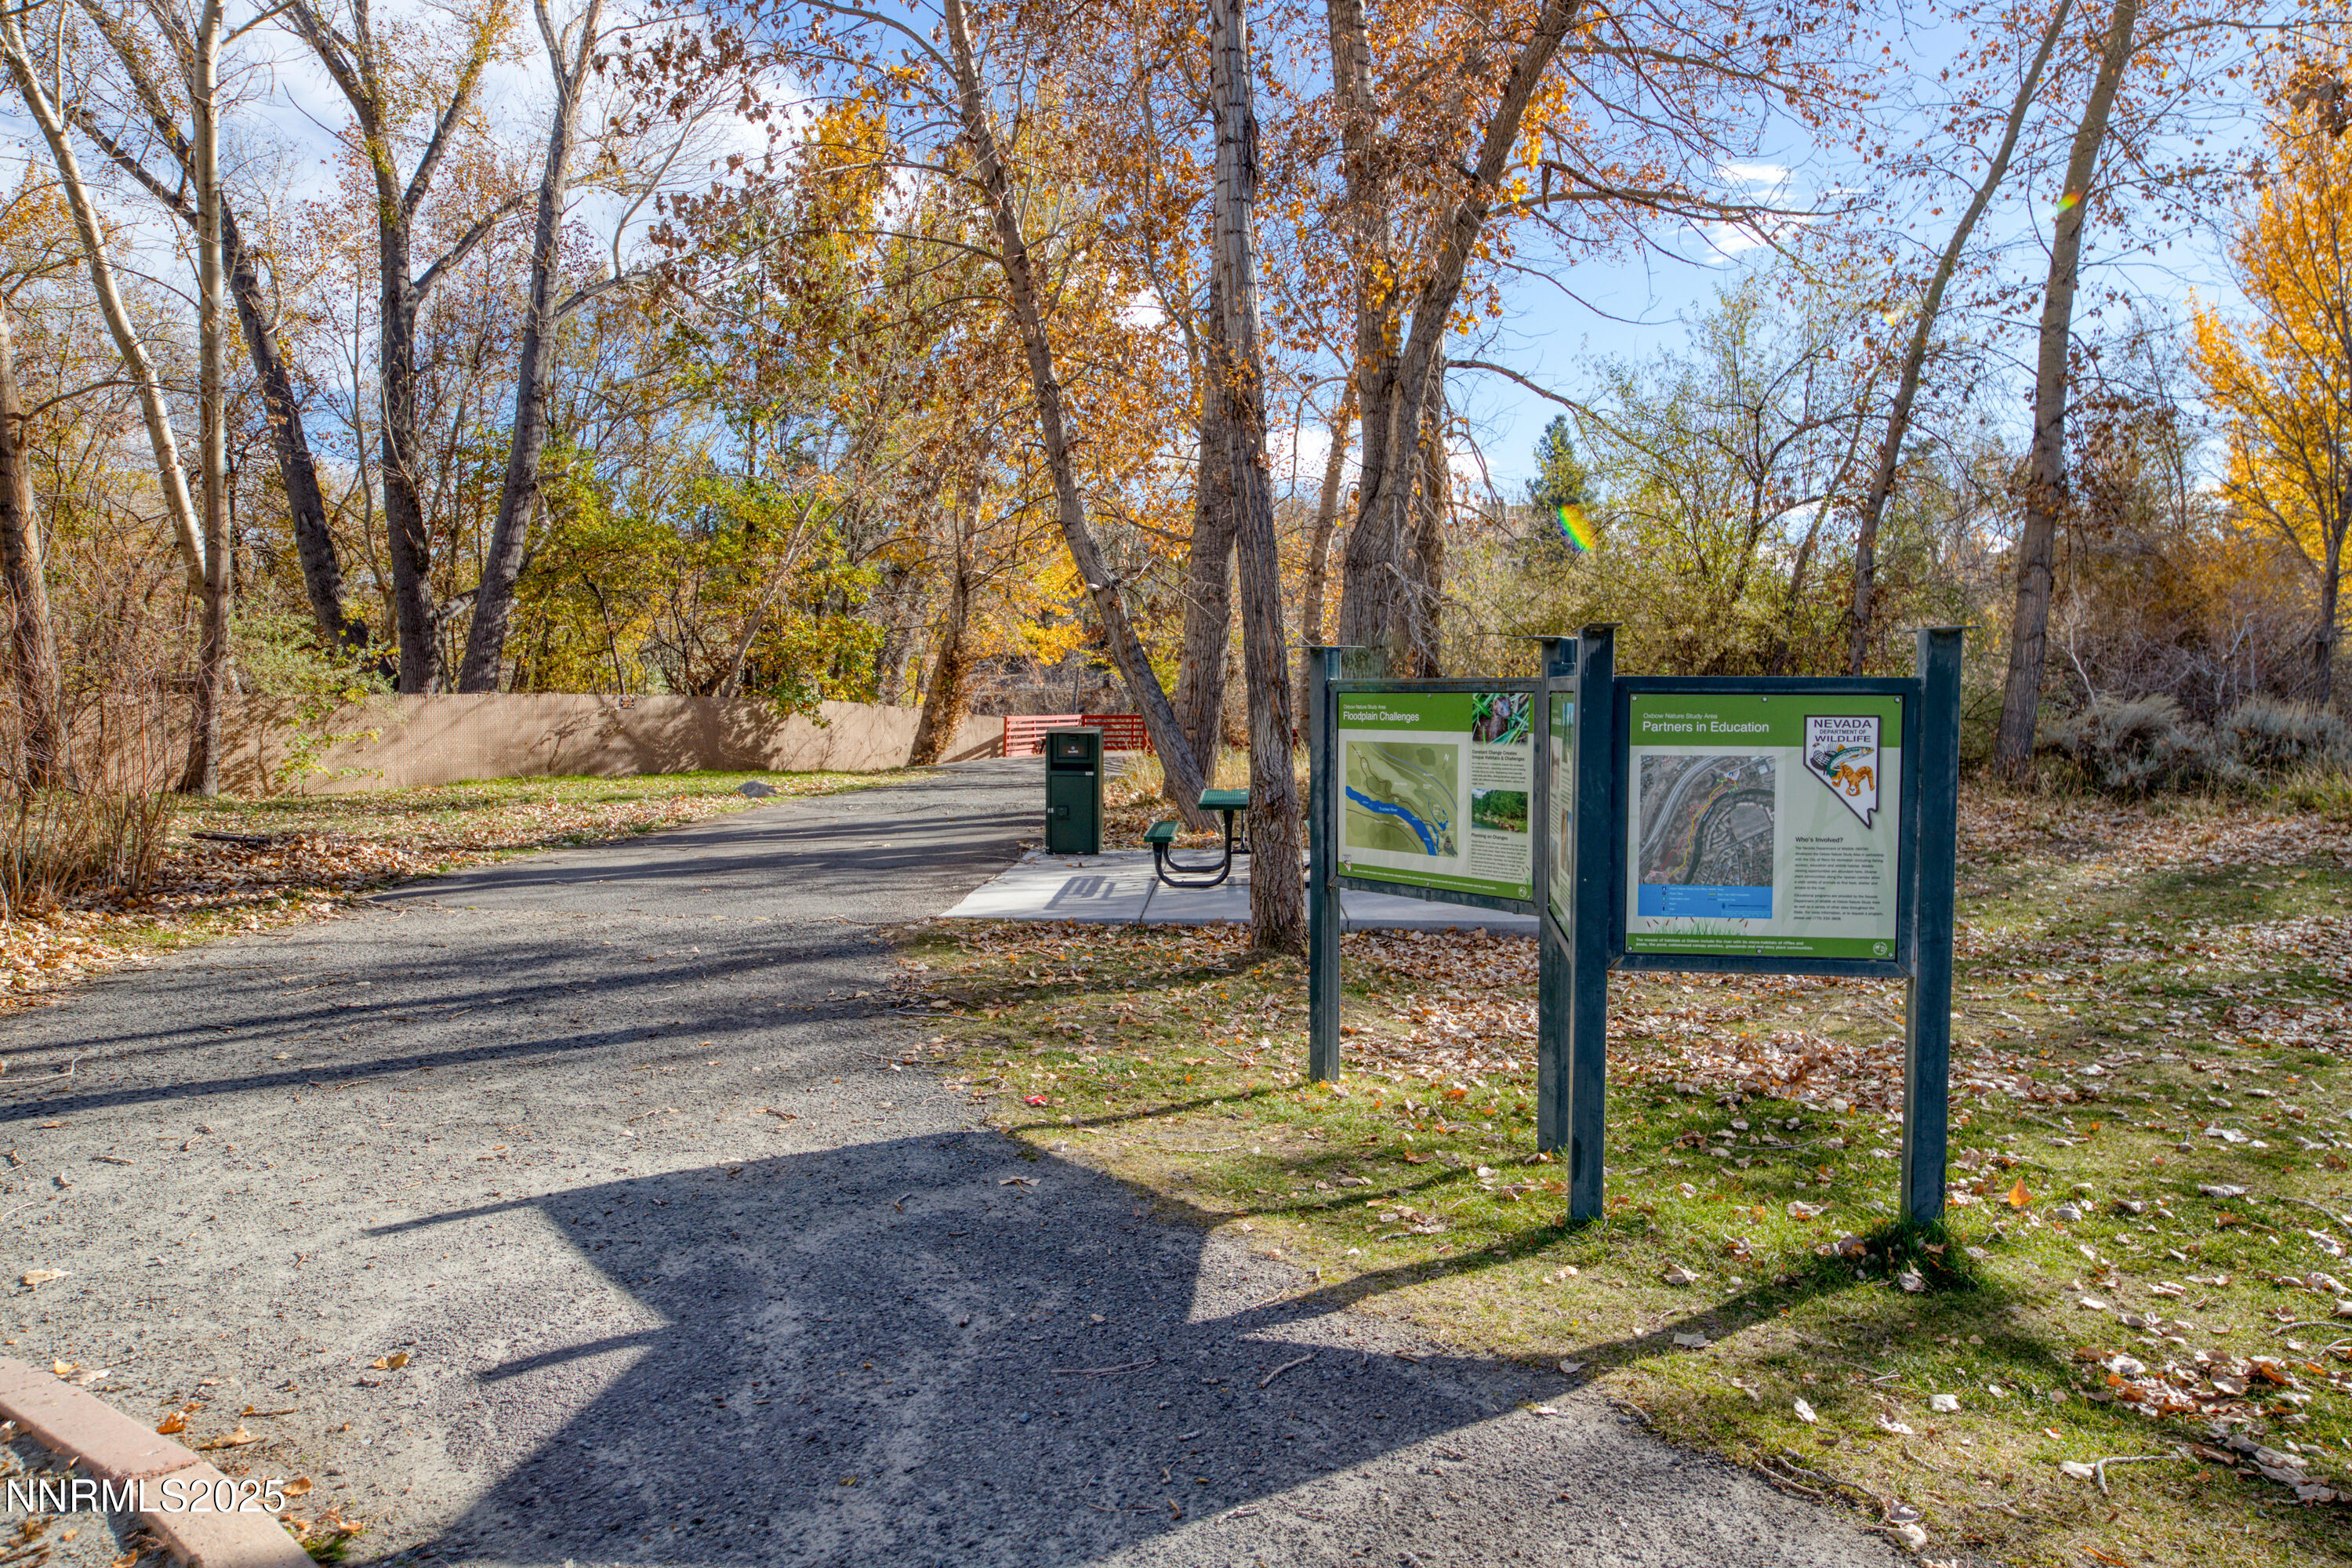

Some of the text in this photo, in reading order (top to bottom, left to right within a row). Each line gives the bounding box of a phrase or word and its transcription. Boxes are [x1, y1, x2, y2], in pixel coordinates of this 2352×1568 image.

[1343, 711, 1419, 723] Floodplain Challenges
[1642, 721, 1769, 732] Partners in Education
